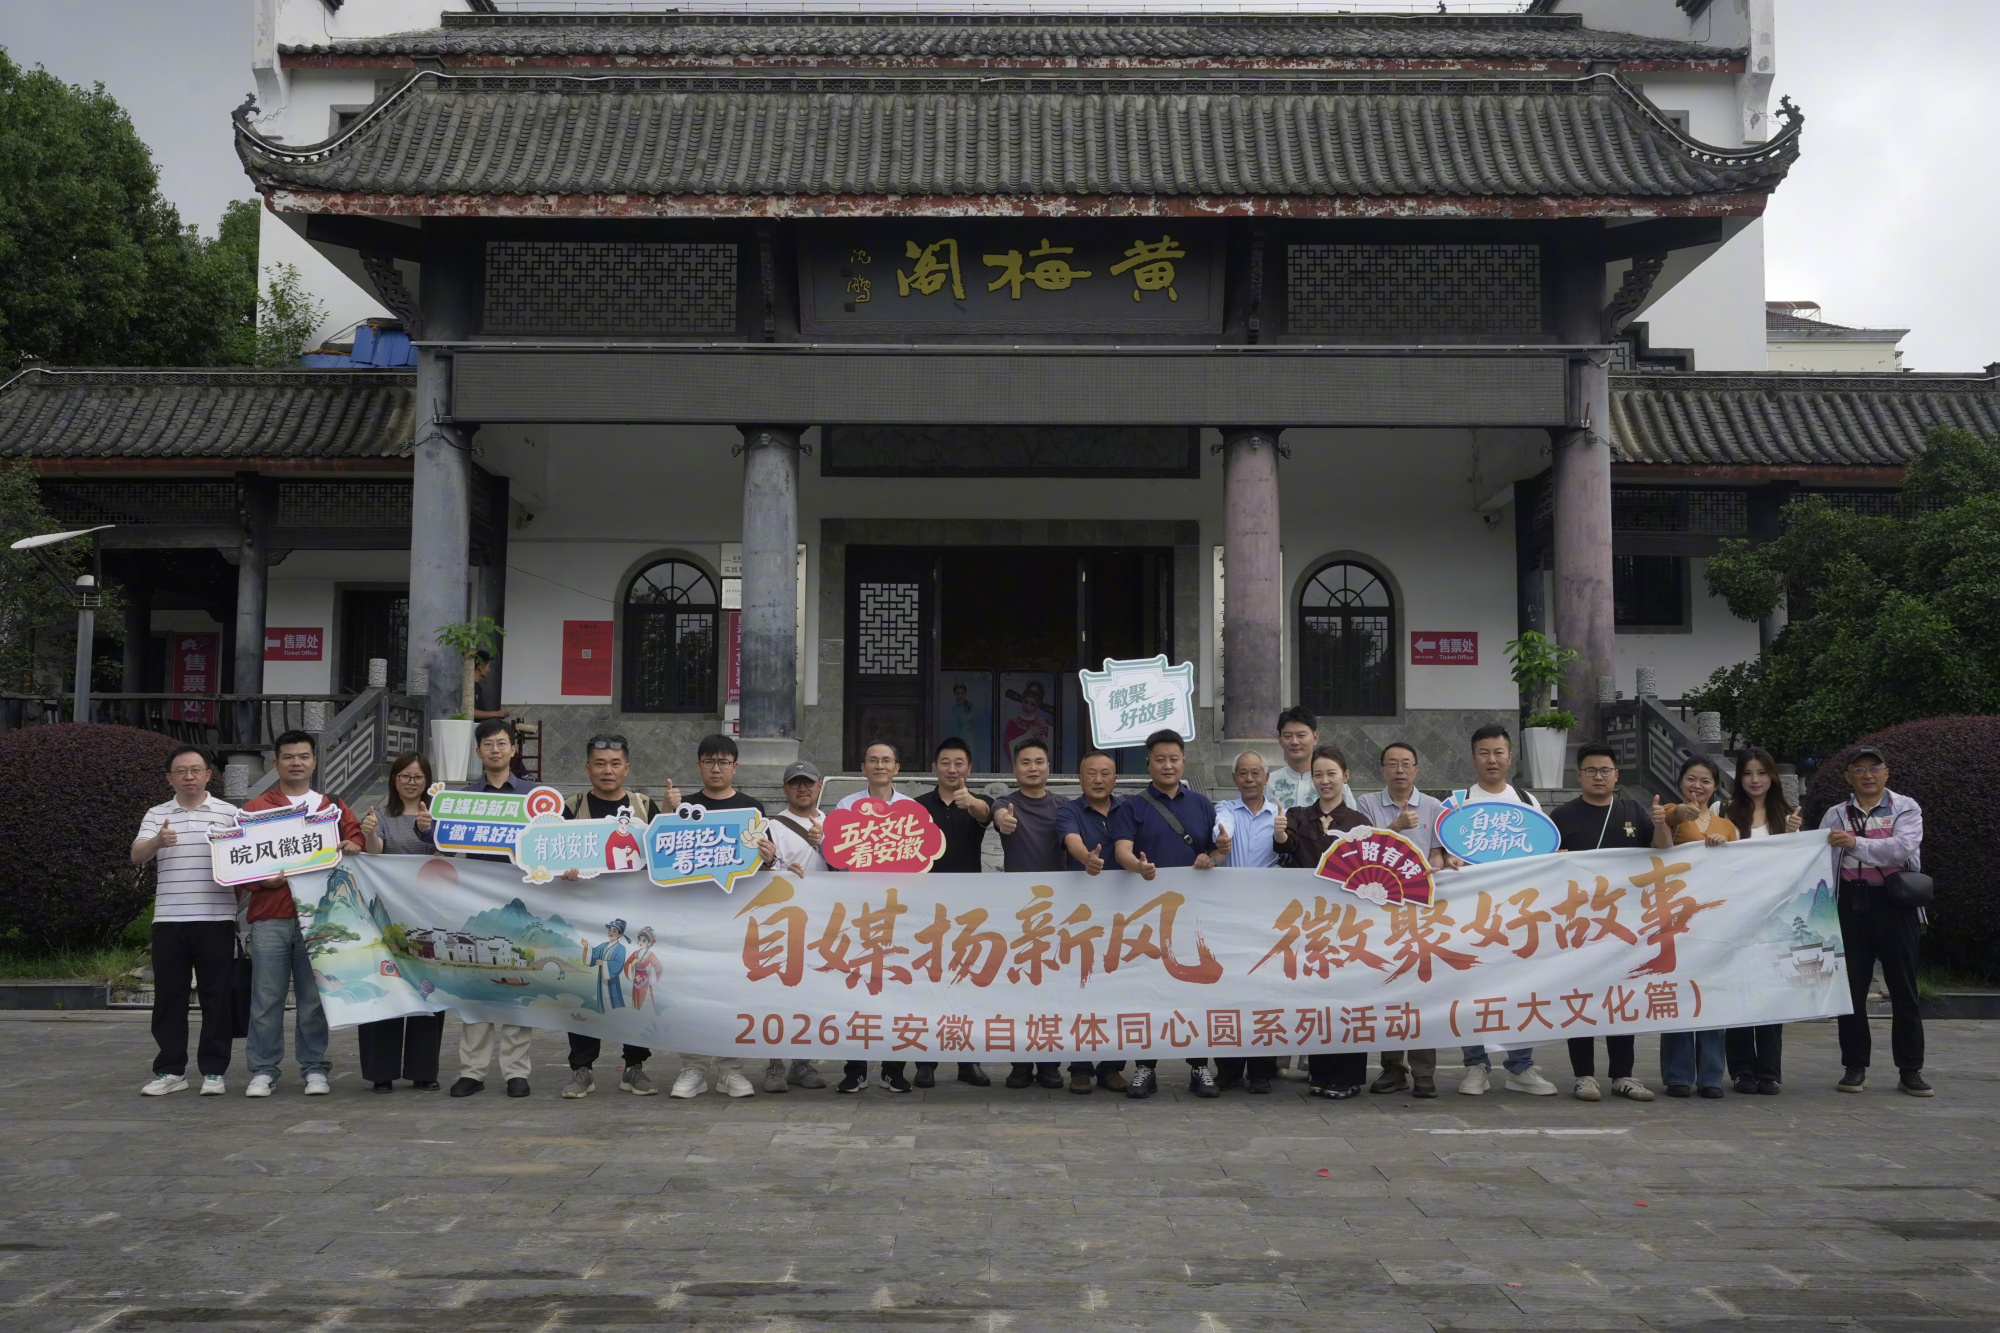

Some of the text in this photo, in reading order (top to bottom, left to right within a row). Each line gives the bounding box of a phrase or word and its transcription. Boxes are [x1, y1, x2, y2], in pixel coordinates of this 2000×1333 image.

[897, 235, 1186, 302] 黄梅阁
[283, 634, 319, 649] 售票处
[1438, 638, 1474, 653] 售票处
[1108, 682, 1148, 711] 徽聚
[1114, 698, 1176, 732] 好故事
[438, 797, 520, 818] 自媒扬新风
[1468, 808, 1525, 832] 自媒
[534, 832, 600, 861] 有戏安庆
[656, 826, 736, 854] 网络达人
[833, 814, 925, 853] 五大文化
[1462, 829, 1533, 857] 扬新风
[230, 832, 323, 866] 皖风徽韵
[672, 847, 742, 875] 看安徽
[848, 836, 927, 868] 看安徽
[1341, 841, 1422, 879] 一路有戏
[734, 856, 1728, 995] 自媒扬新风 徽聚好故事
